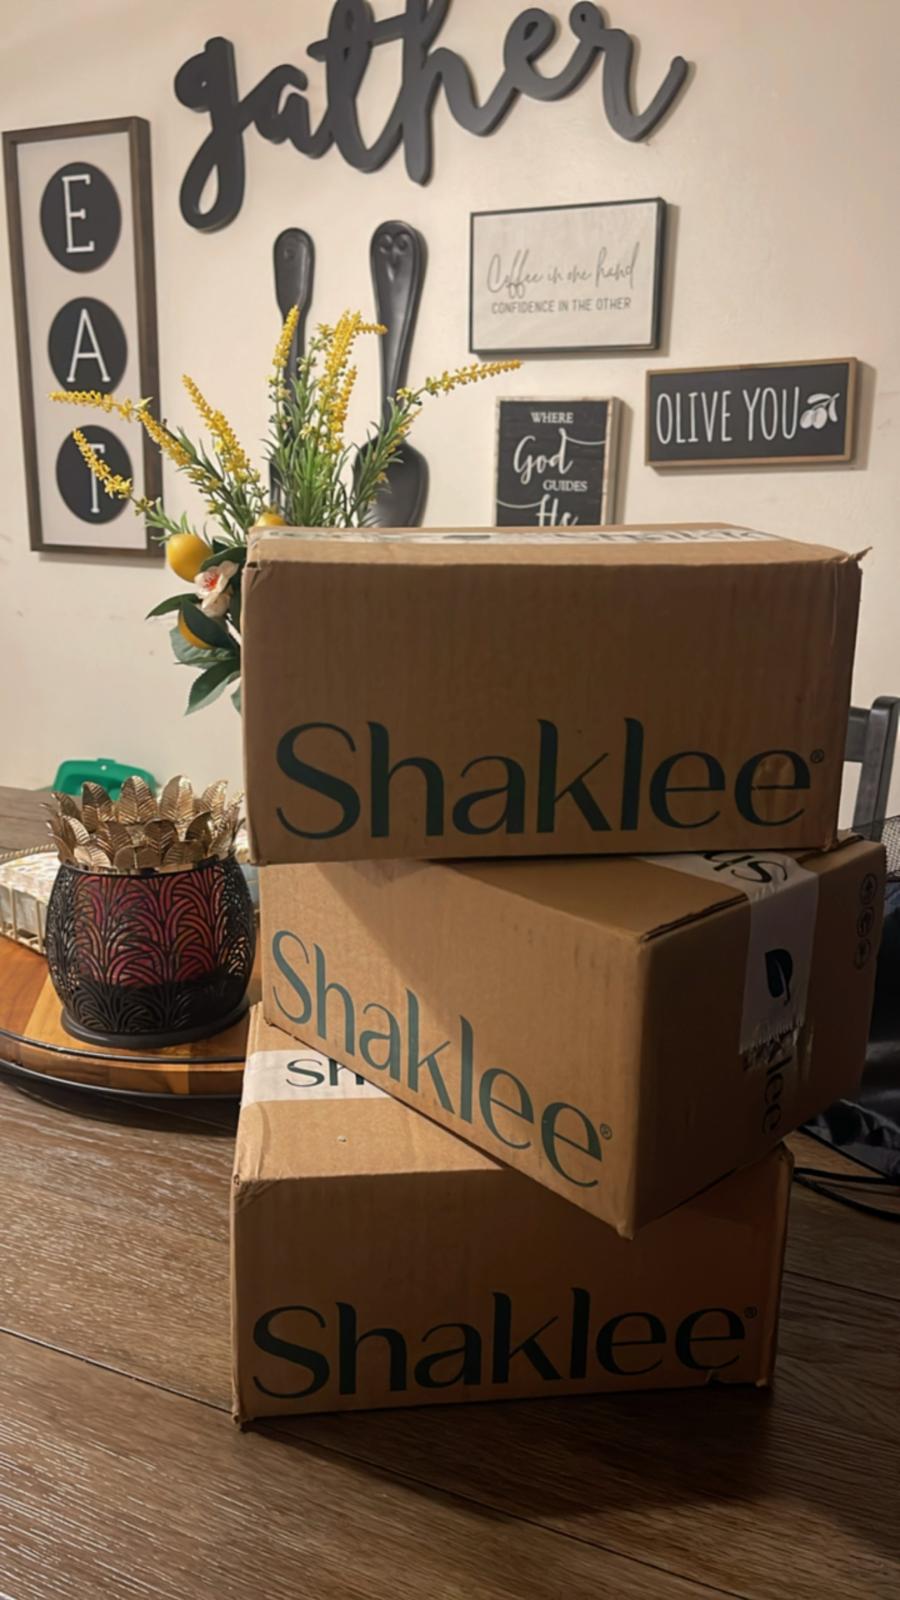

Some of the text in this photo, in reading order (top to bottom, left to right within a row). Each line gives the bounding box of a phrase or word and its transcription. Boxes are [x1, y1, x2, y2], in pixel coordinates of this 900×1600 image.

[174, 0, 688, 232] gather
[487, 241, 640, 299] Coffee in one hand
[491, 297, 632, 314] CONFIDENCE IN THE OTHER
[530, 411, 574, 424] WHERE
[656, 386, 800, 445] OLIVE YOU
[513, 427, 602, 485] God
[542, 479, 588, 492] GUIDES
[276, 718, 811, 840] Shaklee
[271, 930, 603, 1188] Shaklee
[252, 1287, 747, 1400] Shaklee
